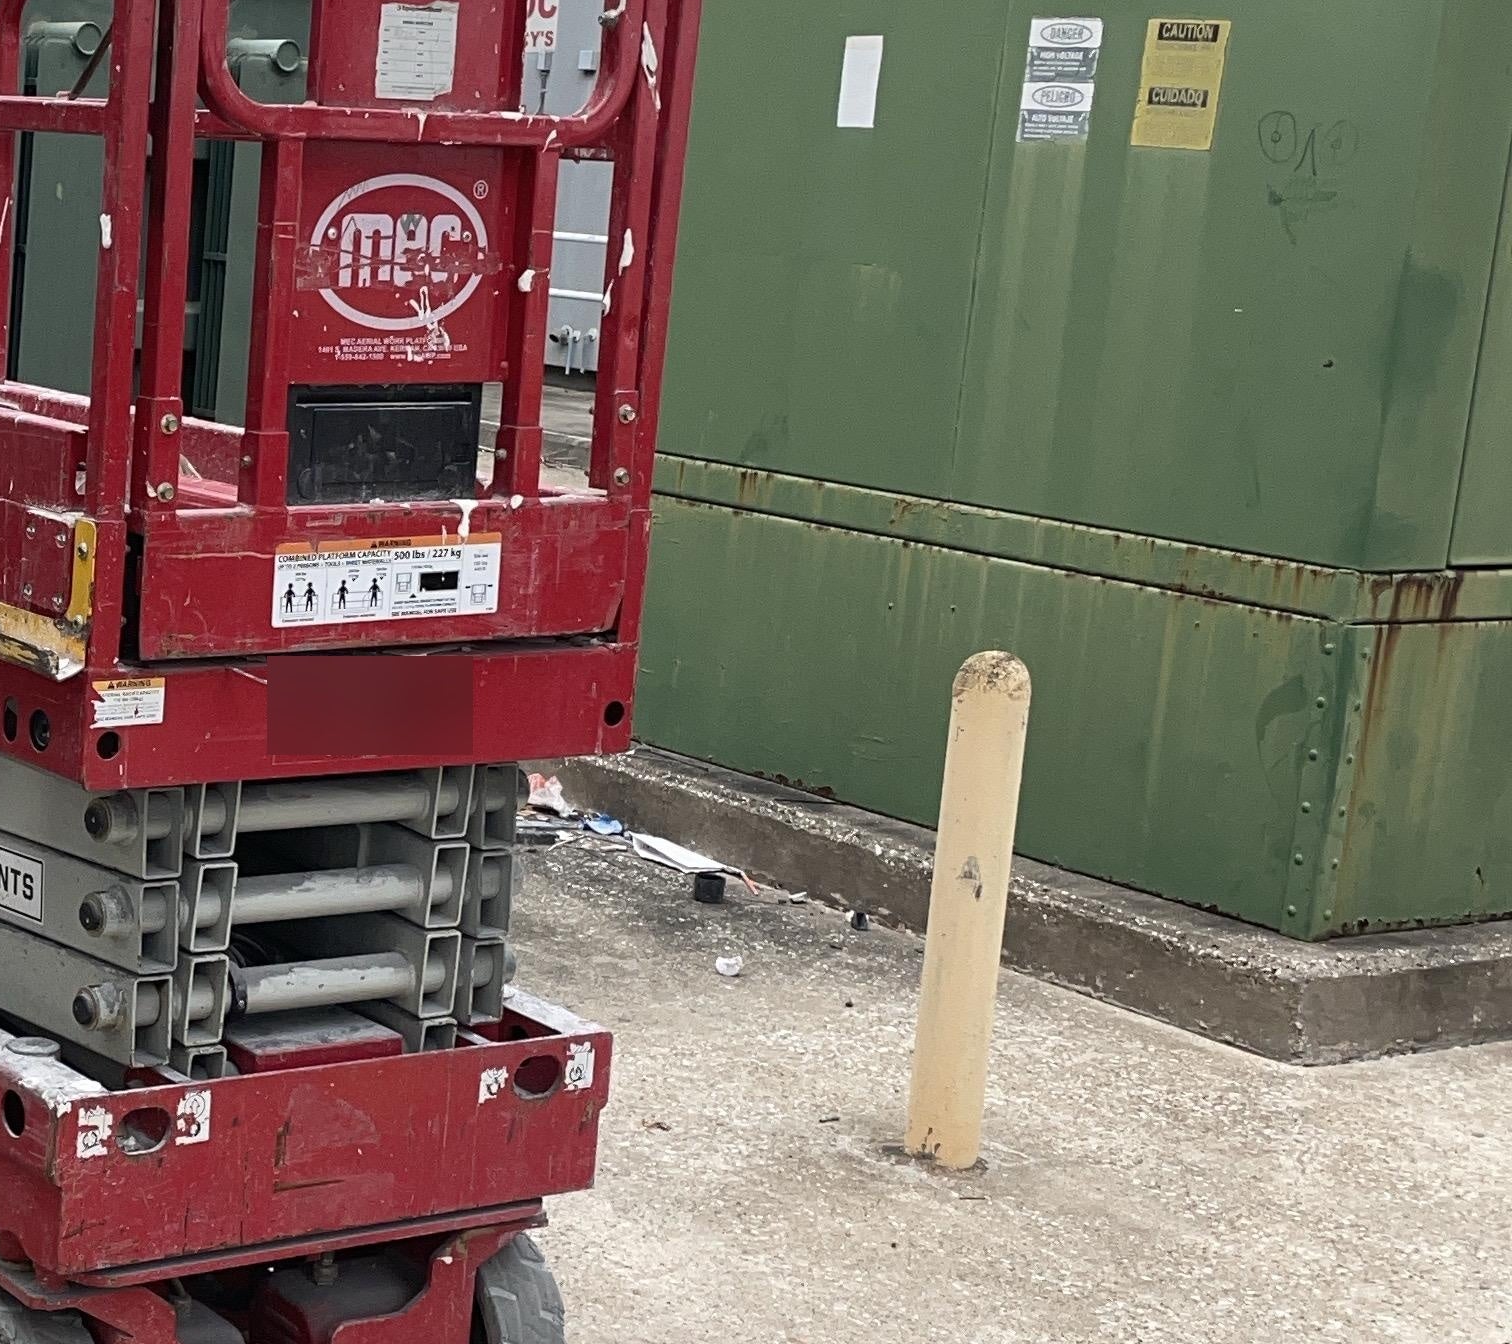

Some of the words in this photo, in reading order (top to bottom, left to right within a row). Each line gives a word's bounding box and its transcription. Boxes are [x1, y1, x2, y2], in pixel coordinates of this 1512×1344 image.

[1161, 22, 1214, 39] CAUTION
[1151, 87, 1204, 105] CUIDADO
[378, 539, 412, 548] WARNING
[278, 554, 317, 563] COMBINED
[318, 551, 356, 560] PLATFORM
[357, 549, 391, 558] CAPACITY
[393, 550, 411, 560] 500
[412, 549, 426, 559] lbs
[432, 548, 449, 558] 227
[450, 548, 462, 559] kg
[116, 680, 152, 688] WARNING
